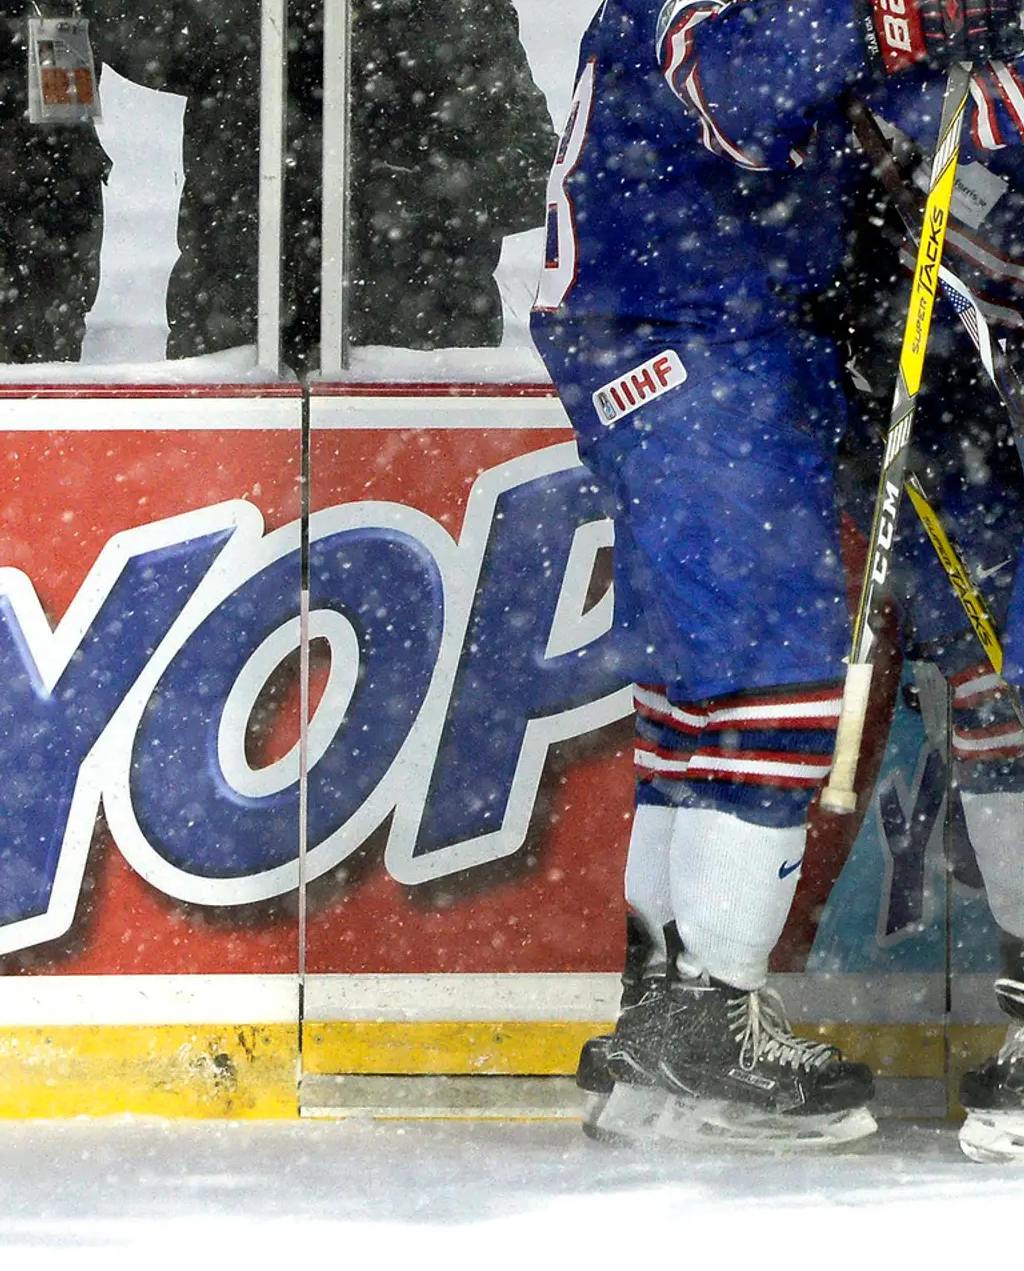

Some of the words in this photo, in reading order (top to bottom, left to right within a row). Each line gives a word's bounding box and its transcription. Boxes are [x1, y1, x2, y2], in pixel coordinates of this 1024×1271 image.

[917, 206, 945, 296] TACKS
[911, 298, 928, 354] SUPER
[610, 356, 672, 412] IIHF
[871, 480, 899, 585] CCM
